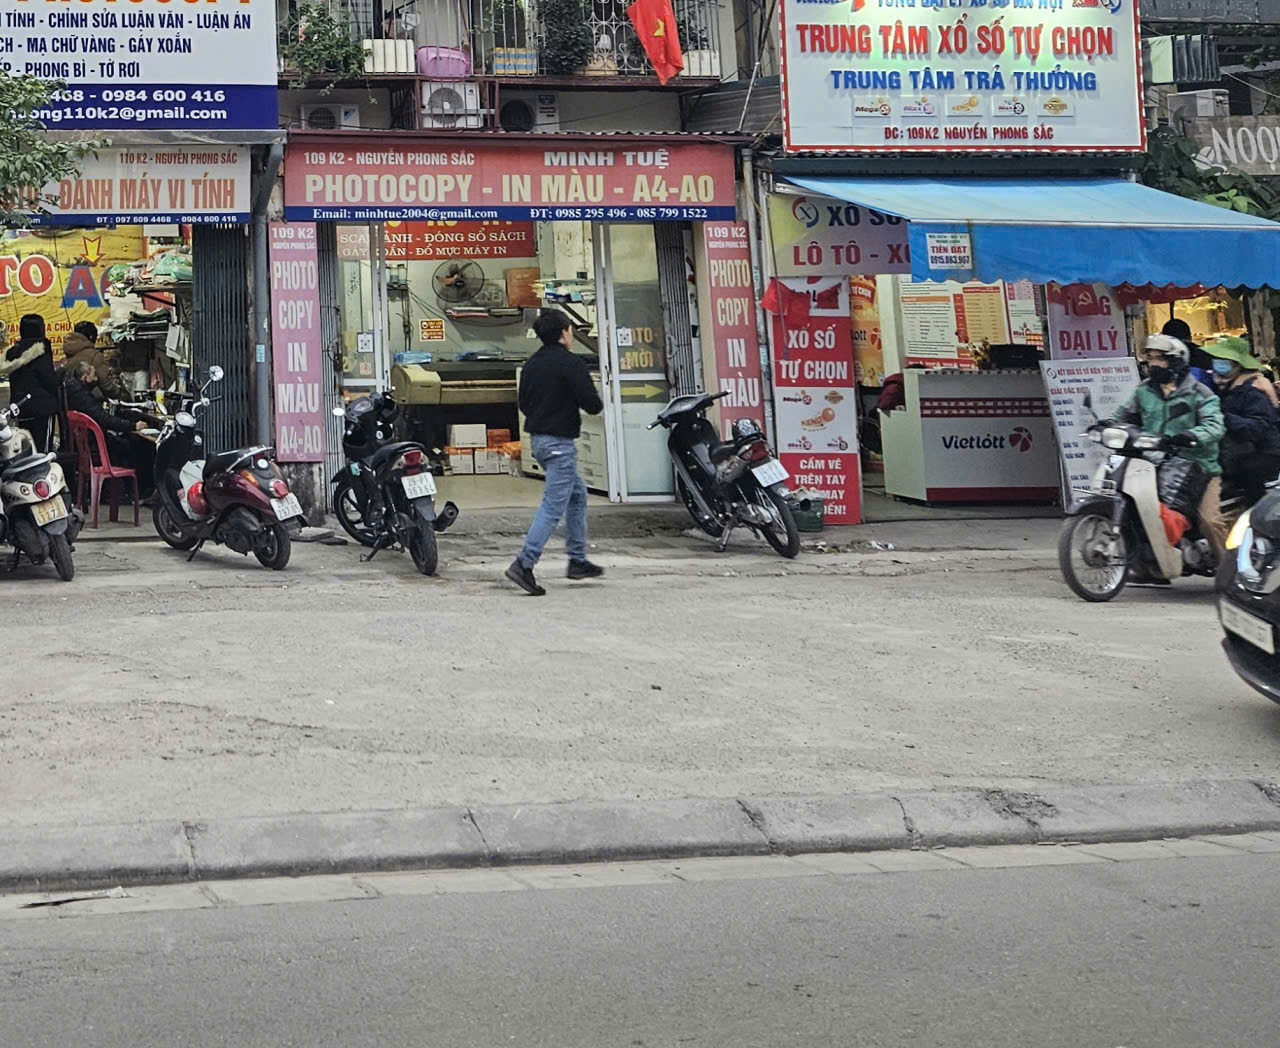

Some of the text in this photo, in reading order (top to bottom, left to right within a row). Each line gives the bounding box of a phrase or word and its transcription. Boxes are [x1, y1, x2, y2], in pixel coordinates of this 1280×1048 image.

[6, 9, 35, 27] TÍNH
[48, 8, 88, 28] CHỈNH
[92, 8, 118, 29] SỬA
[121, 11, 154, 32] LUẬN
[158, 11, 184, 29] VĂN
[196, 11, 229, 32] LUẬN
[233, 11, 251, 29] ÁN
[27, 37, 47, 57] MẠ
[51, 35, 79, 53] CHỮ
[81, 35, 115, 53] VÀNG
[129, 34, 153, 53] GÁY
[158, 32, 192, 53] XOẮN
[796, 13, 1113, 60] TRUNG TÂM XỔ SỐ TỰ CHỌN
[25, 59, 140, 78] PHONG BÌ TỜ RƠI
[831, 64, 1097, 90] TRUNG TÂM TRẢ THƯỞNG
[102, 90, 225, 102] 0984 600 416
[993, 126, 1029, 140] PHONG
[1033, 123, 1054, 140] SẮC
[120, 152, 134, 164] 110
[136, 153, 148, 164] K2
[192, 152, 219, 164] PHONG
[304, 152, 326, 164] 109
[329, 152, 345, 164] K2
[407, 152, 448, 165] PHONG
[544, 148, 669, 169] MINH TUỆ
[59, 172, 113, 210] ĐÁNH
[120, 172, 162, 209] MÁY
[168, 179, 185, 209] VI
[192, 172, 235, 209] TÍNH
[305, 174, 472, 203] PHOTOCOPY
[502, 174, 531, 202] IN
[541, 169, 604, 202] MÀU
[313, 209, 352, 219] Email:
[556, 208, 582, 218] 0985
[585, 208, 604, 218] 295
[607, 208, 626, 218] 496
[637, 208, 656, 218] 085
[660, 208, 679, 218] 799
[683, 208, 708, 218] 1522
[272, 227, 314, 239] 109 K2
[424, 231, 465, 243] ĐÓNG
[707, 226, 747, 238] 109 K2
[494, 246, 507, 255] IN
[793, 240, 861, 266] LÔ TÔ
[272, 260, 317, 290] PHOTO
[710, 259, 751, 288] PHOTO
[278, 299, 314, 330] COPY
[717, 297, 749, 327] COPY
[814, 323, 836, 349] SỐ
[1059, 326, 1119, 356] ĐẠI LÝ
[287, 342, 308, 372] IN
[727, 338, 747, 368] IN
[780, 359, 848, 384] TỰ CHỌN
[278, 376, 319, 414] MÀU
[720, 371, 760, 408] MÀU
[794, 473, 822, 485] TRÊN
[826, 474, 846, 485] TAY
